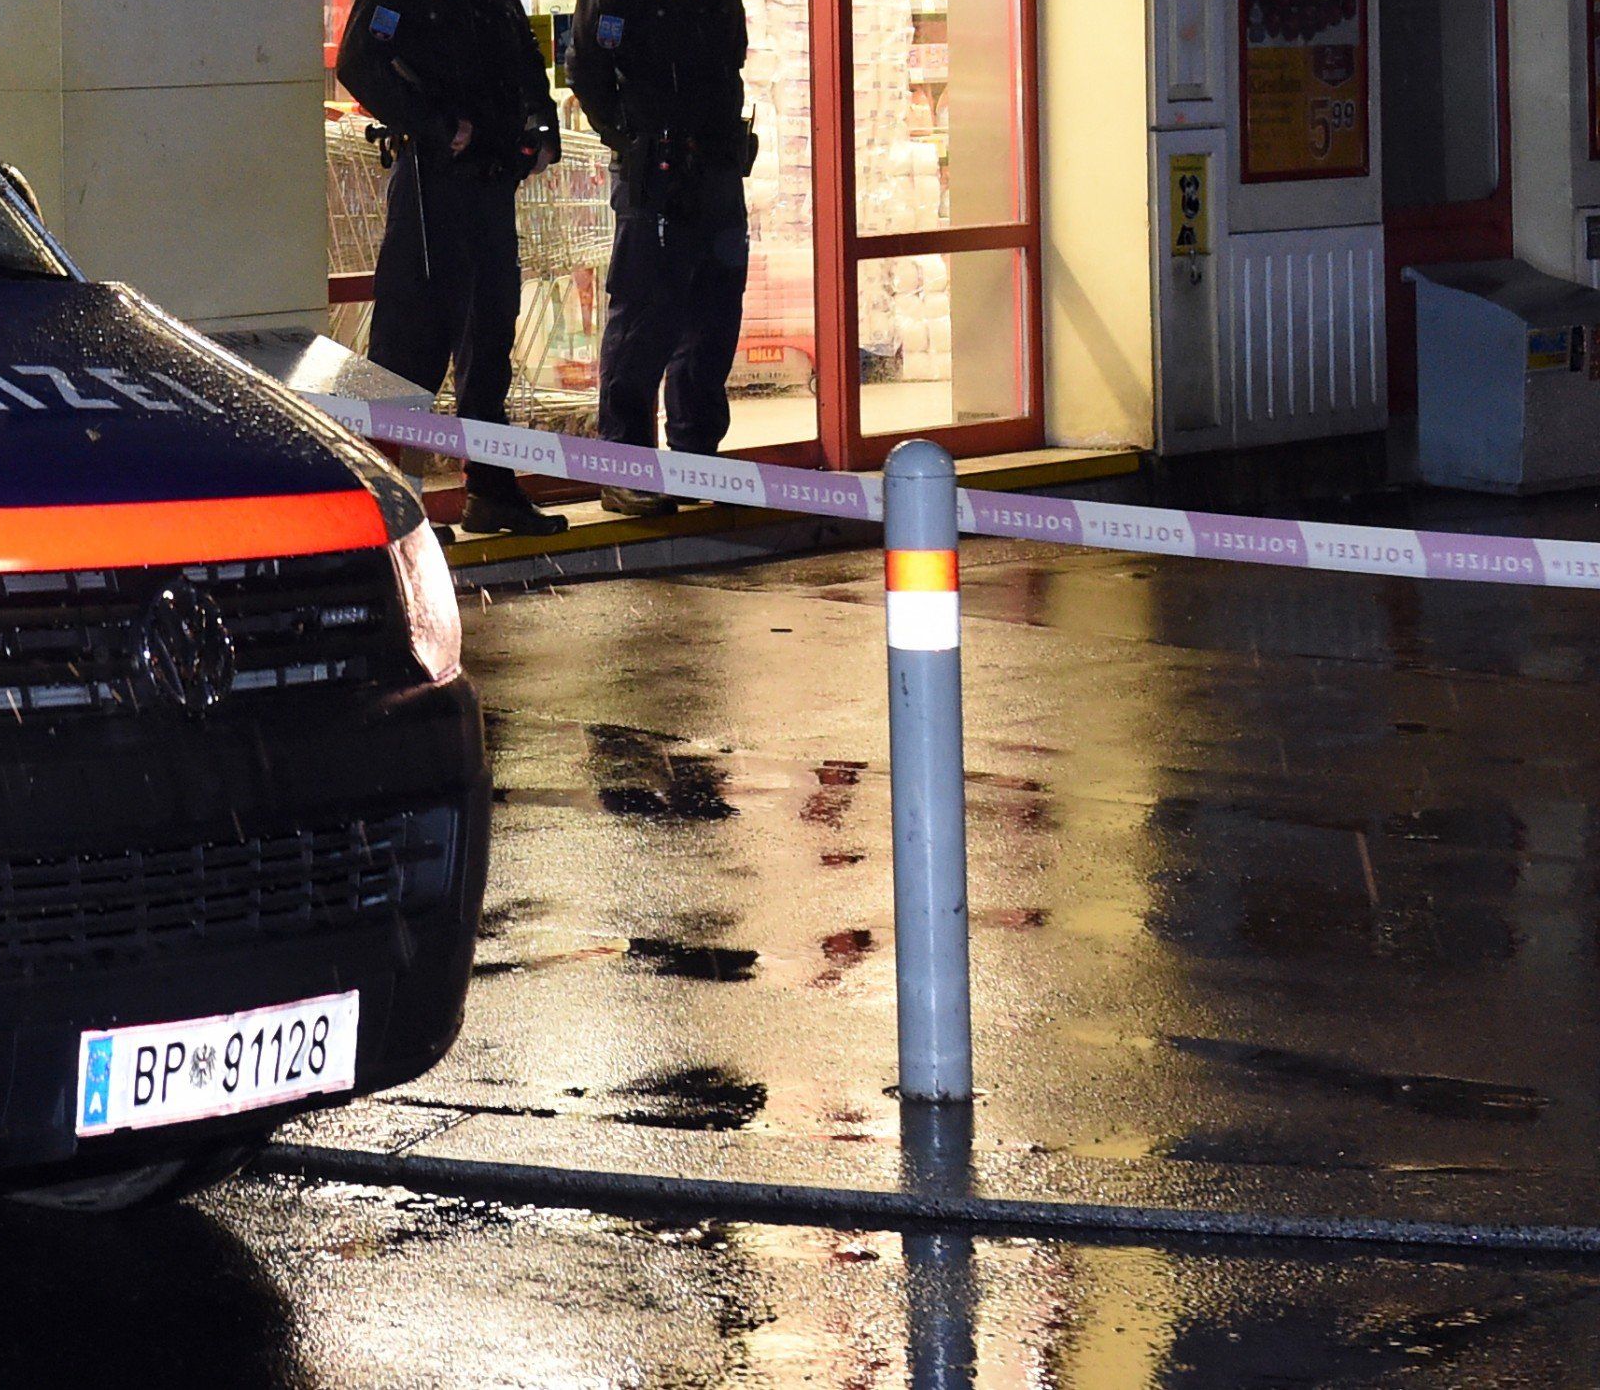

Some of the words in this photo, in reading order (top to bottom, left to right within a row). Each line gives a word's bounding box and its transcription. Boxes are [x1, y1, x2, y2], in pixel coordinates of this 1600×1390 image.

[748, 347, 783, 362] BILLA
[133, 1040, 187, 1107] BP
[222, 1014, 330, 1093] 91128
